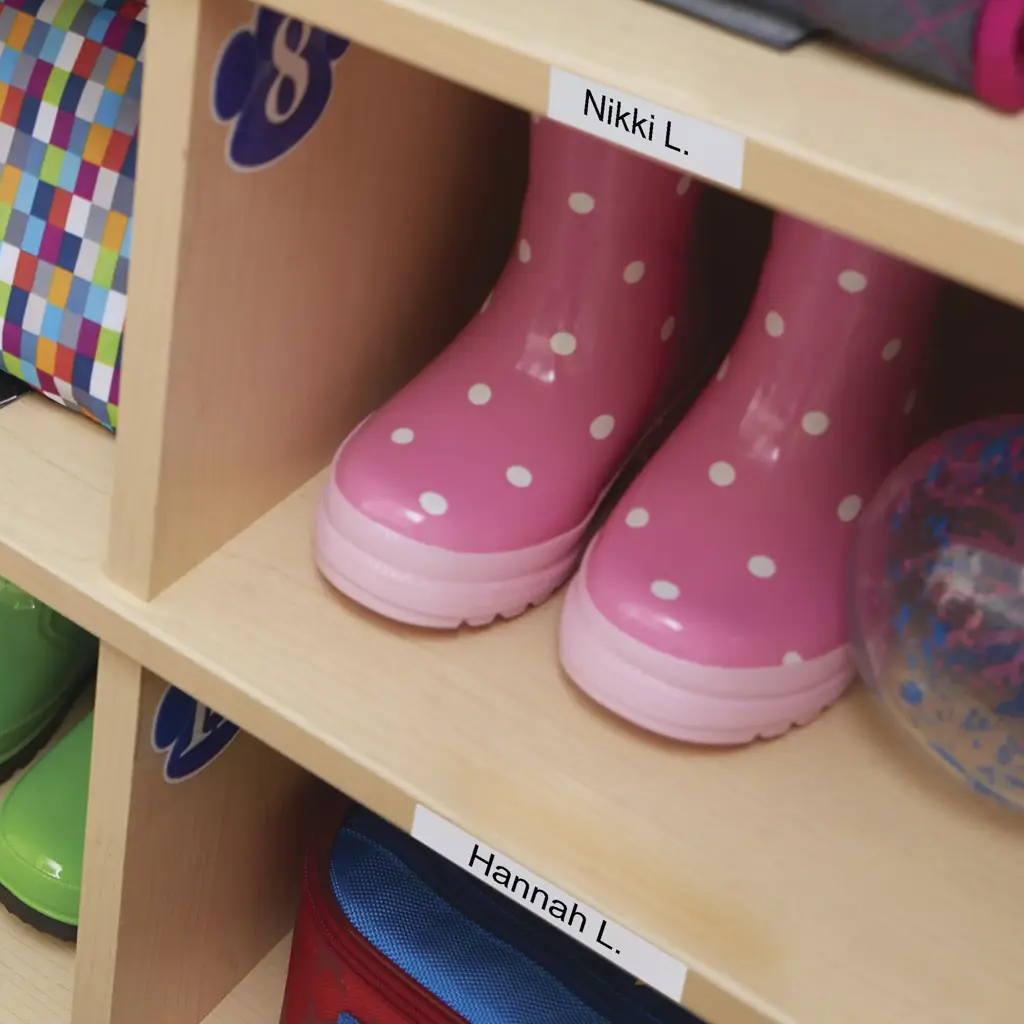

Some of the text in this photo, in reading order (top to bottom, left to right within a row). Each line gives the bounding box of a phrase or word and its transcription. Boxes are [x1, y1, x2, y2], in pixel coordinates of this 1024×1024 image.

[264, 16, 313, 125] 8
[582, 88, 690, 156] Nikki L.
[466, 843, 623, 955] Hannah L.
